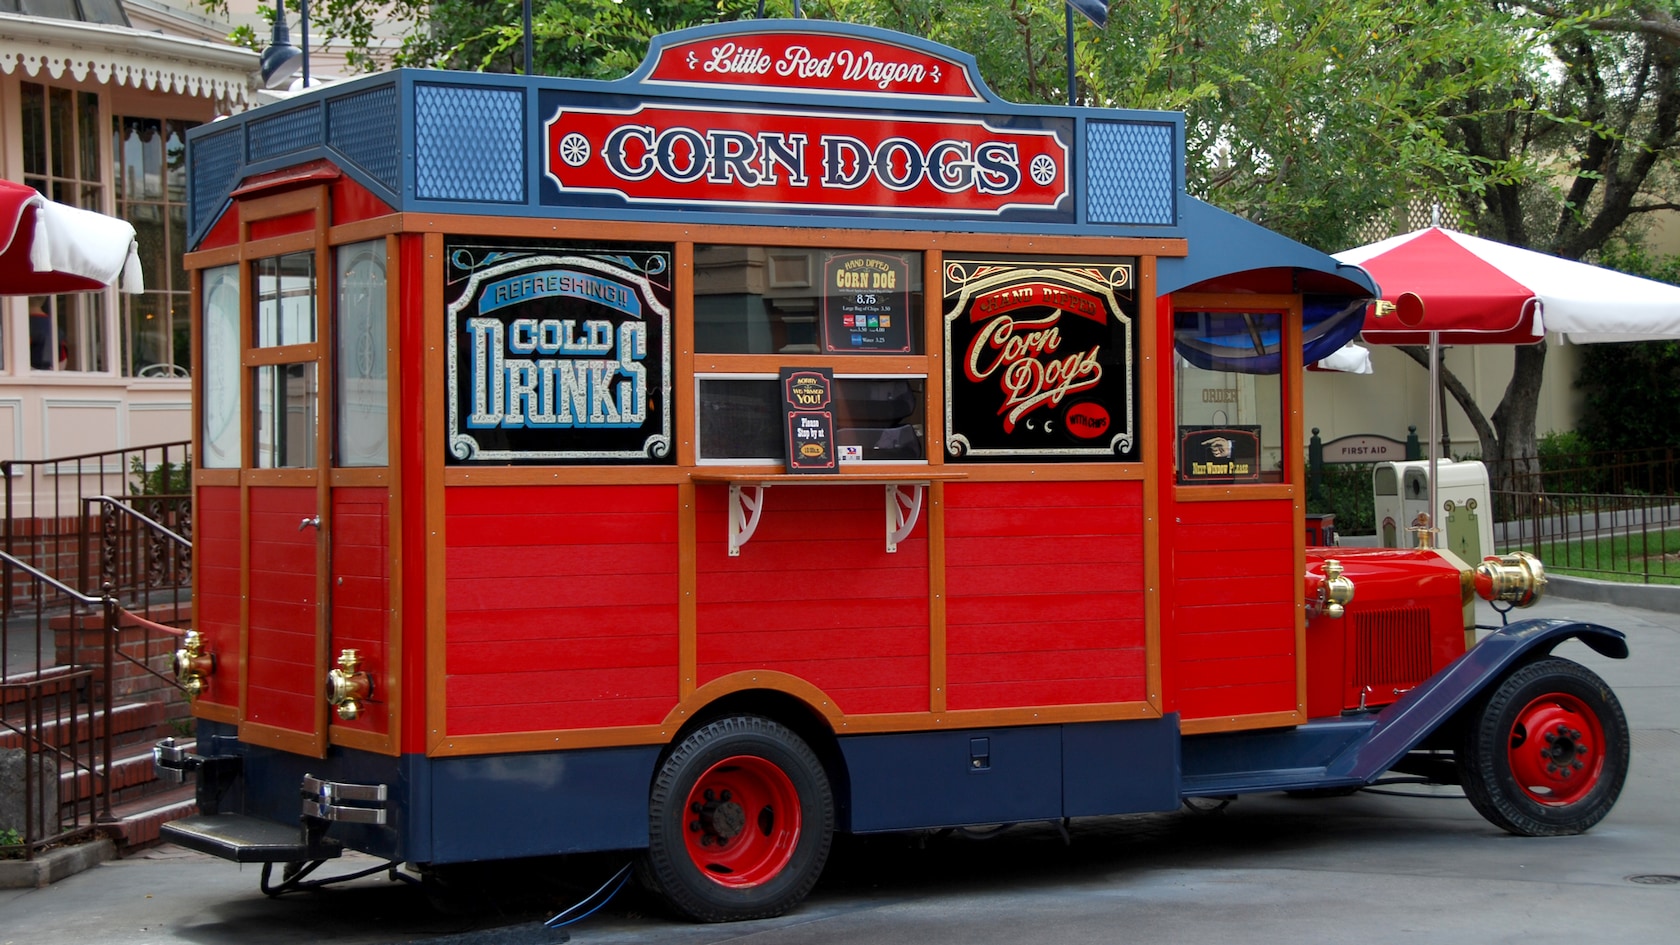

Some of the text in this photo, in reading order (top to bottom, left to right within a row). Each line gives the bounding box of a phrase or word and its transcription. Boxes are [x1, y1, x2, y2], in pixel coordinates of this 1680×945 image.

[703, 43, 926, 90] Little Red Wagon
[601, 125, 1022, 195] CORN DOGS
[836, 269, 896, 289] CORN DOG
[845, 259, 889, 272] HAND DIPPED
[495, 275, 628, 309] REFRESHING!!
[856, 294, 876, 304] 8.75
[980, 288, 1097, 316] HAND DIPPED
[509, 319, 614, 354] COLD
[965, 308, 1062, 381] Corn
[467, 318, 647, 428] DRINKS
[1000, 345, 1103, 425] Dogs
[797, 395, 821, 404] YOU!
[1202, 388, 1238, 403] ORDER
[797, 427, 810, 439] Stop
[810, 427, 818, 439] by
[801, 417, 820, 427] Please
